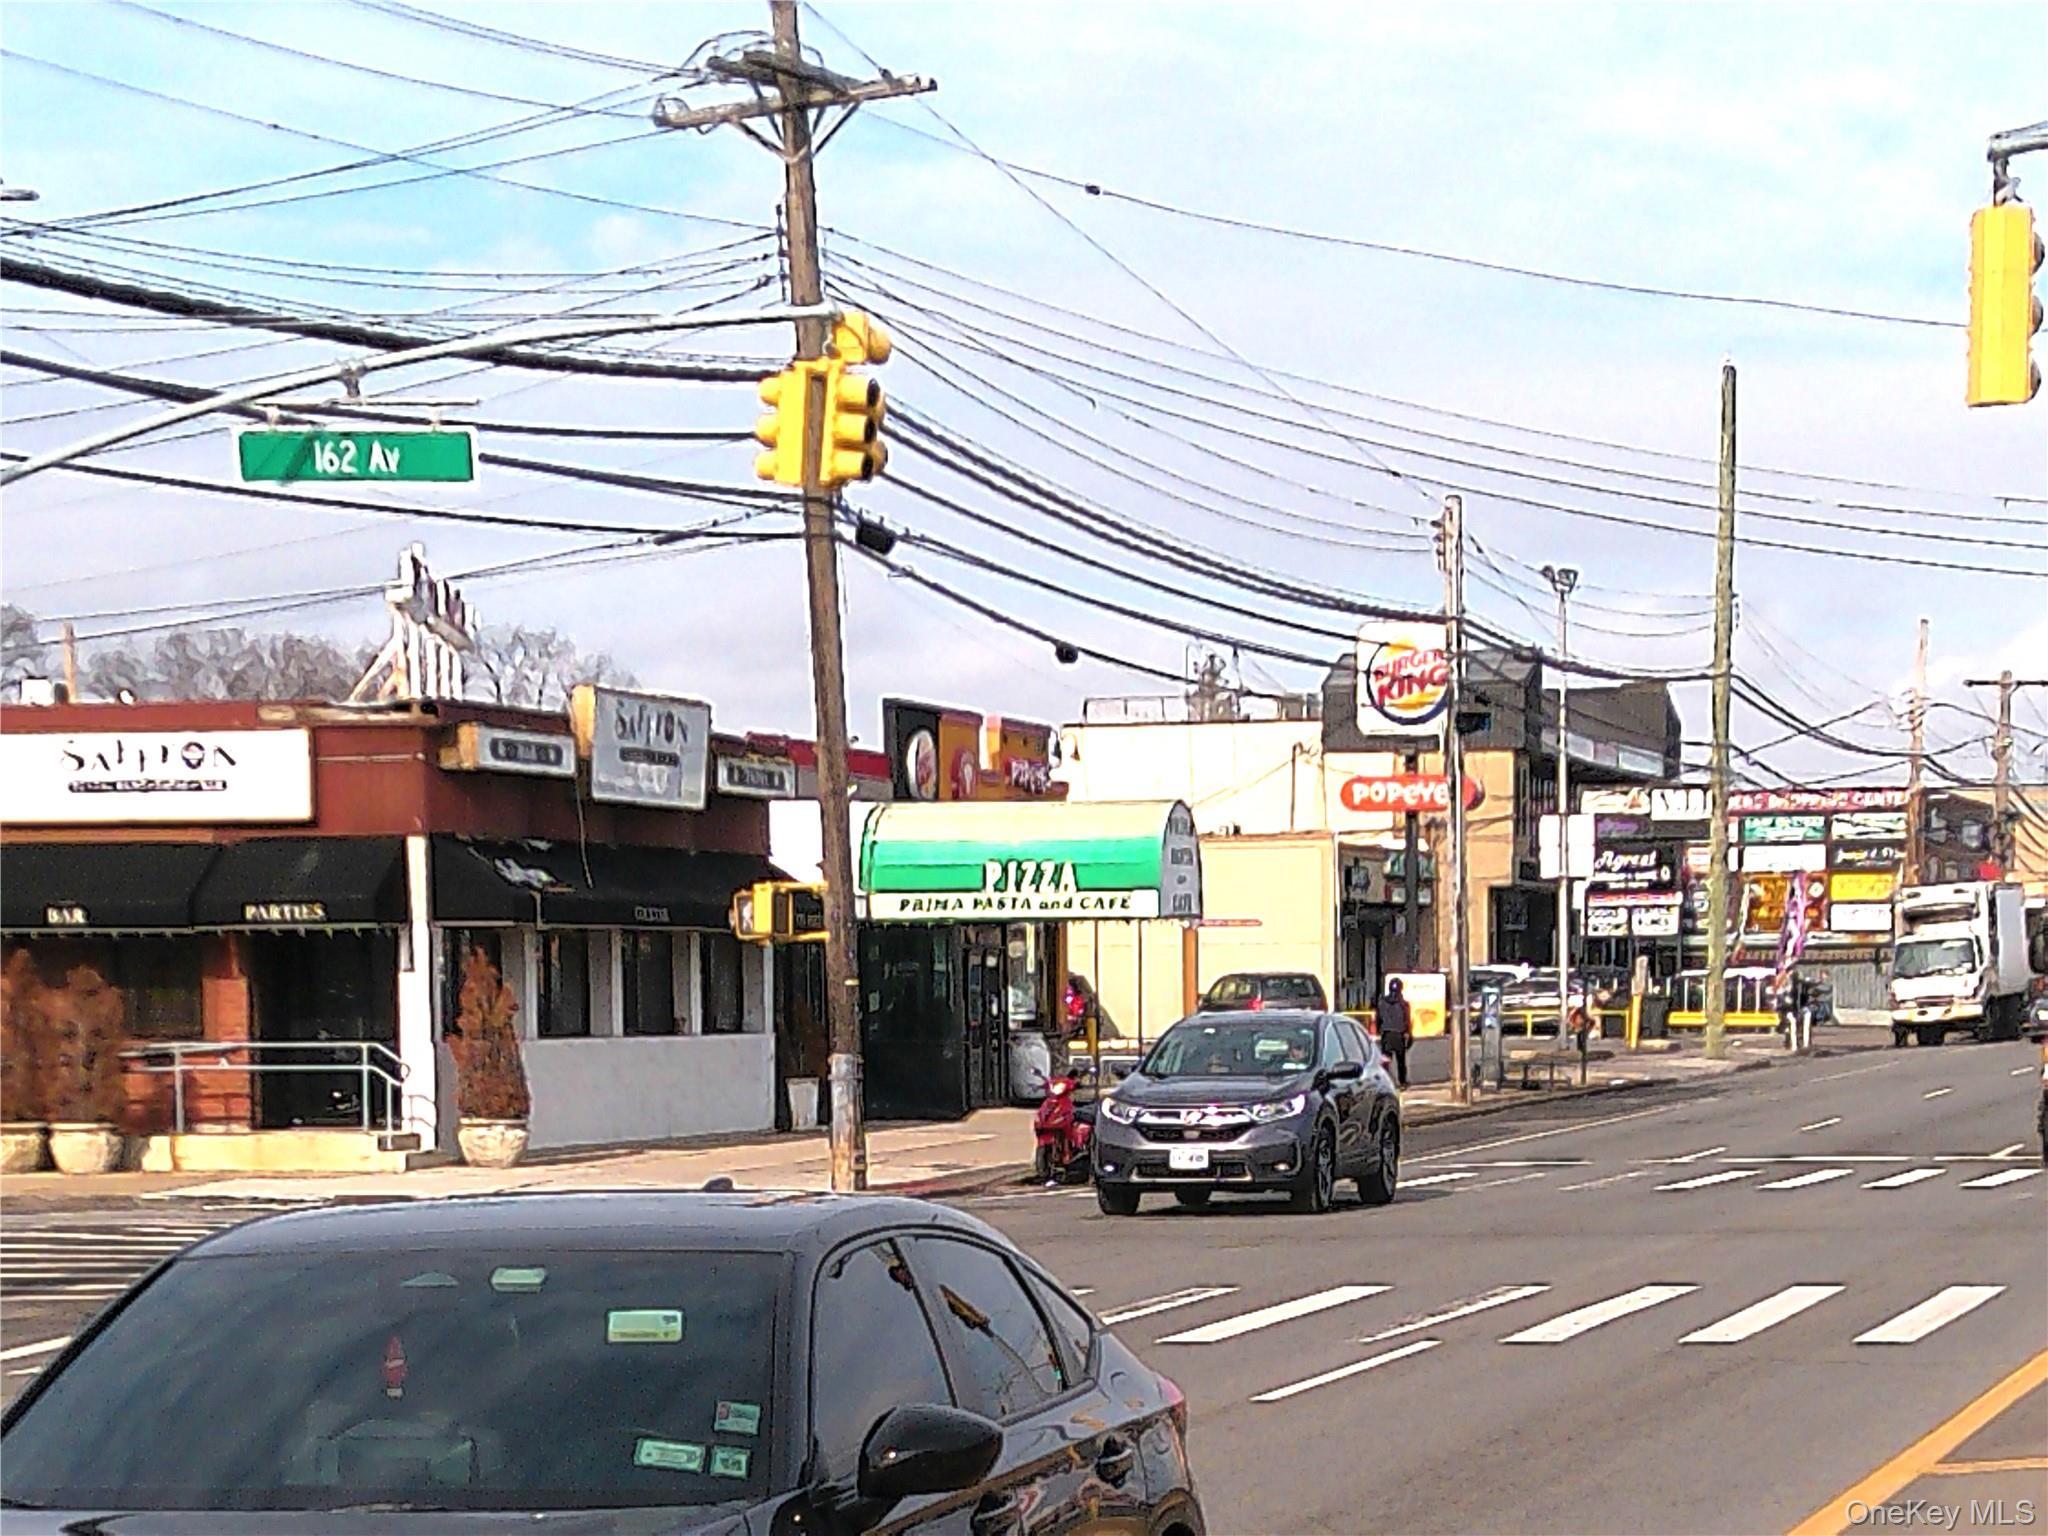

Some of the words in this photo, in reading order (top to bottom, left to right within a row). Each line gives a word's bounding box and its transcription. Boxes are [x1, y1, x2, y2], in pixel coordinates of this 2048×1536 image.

[313, 439, 359, 474] 162
[368, 440, 400, 474] Av
[1377, 664, 1450, 705] KING
[981, 857, 1080, 893] PIZZA
[46, 906, 87, 924] BAR
[244, 902, 326, 922] PARTIES
[899, 898, 964, 913] PRIMA
[972, 897, 1032, 911] PASTA
[1038, 895, 1074, 910] and
